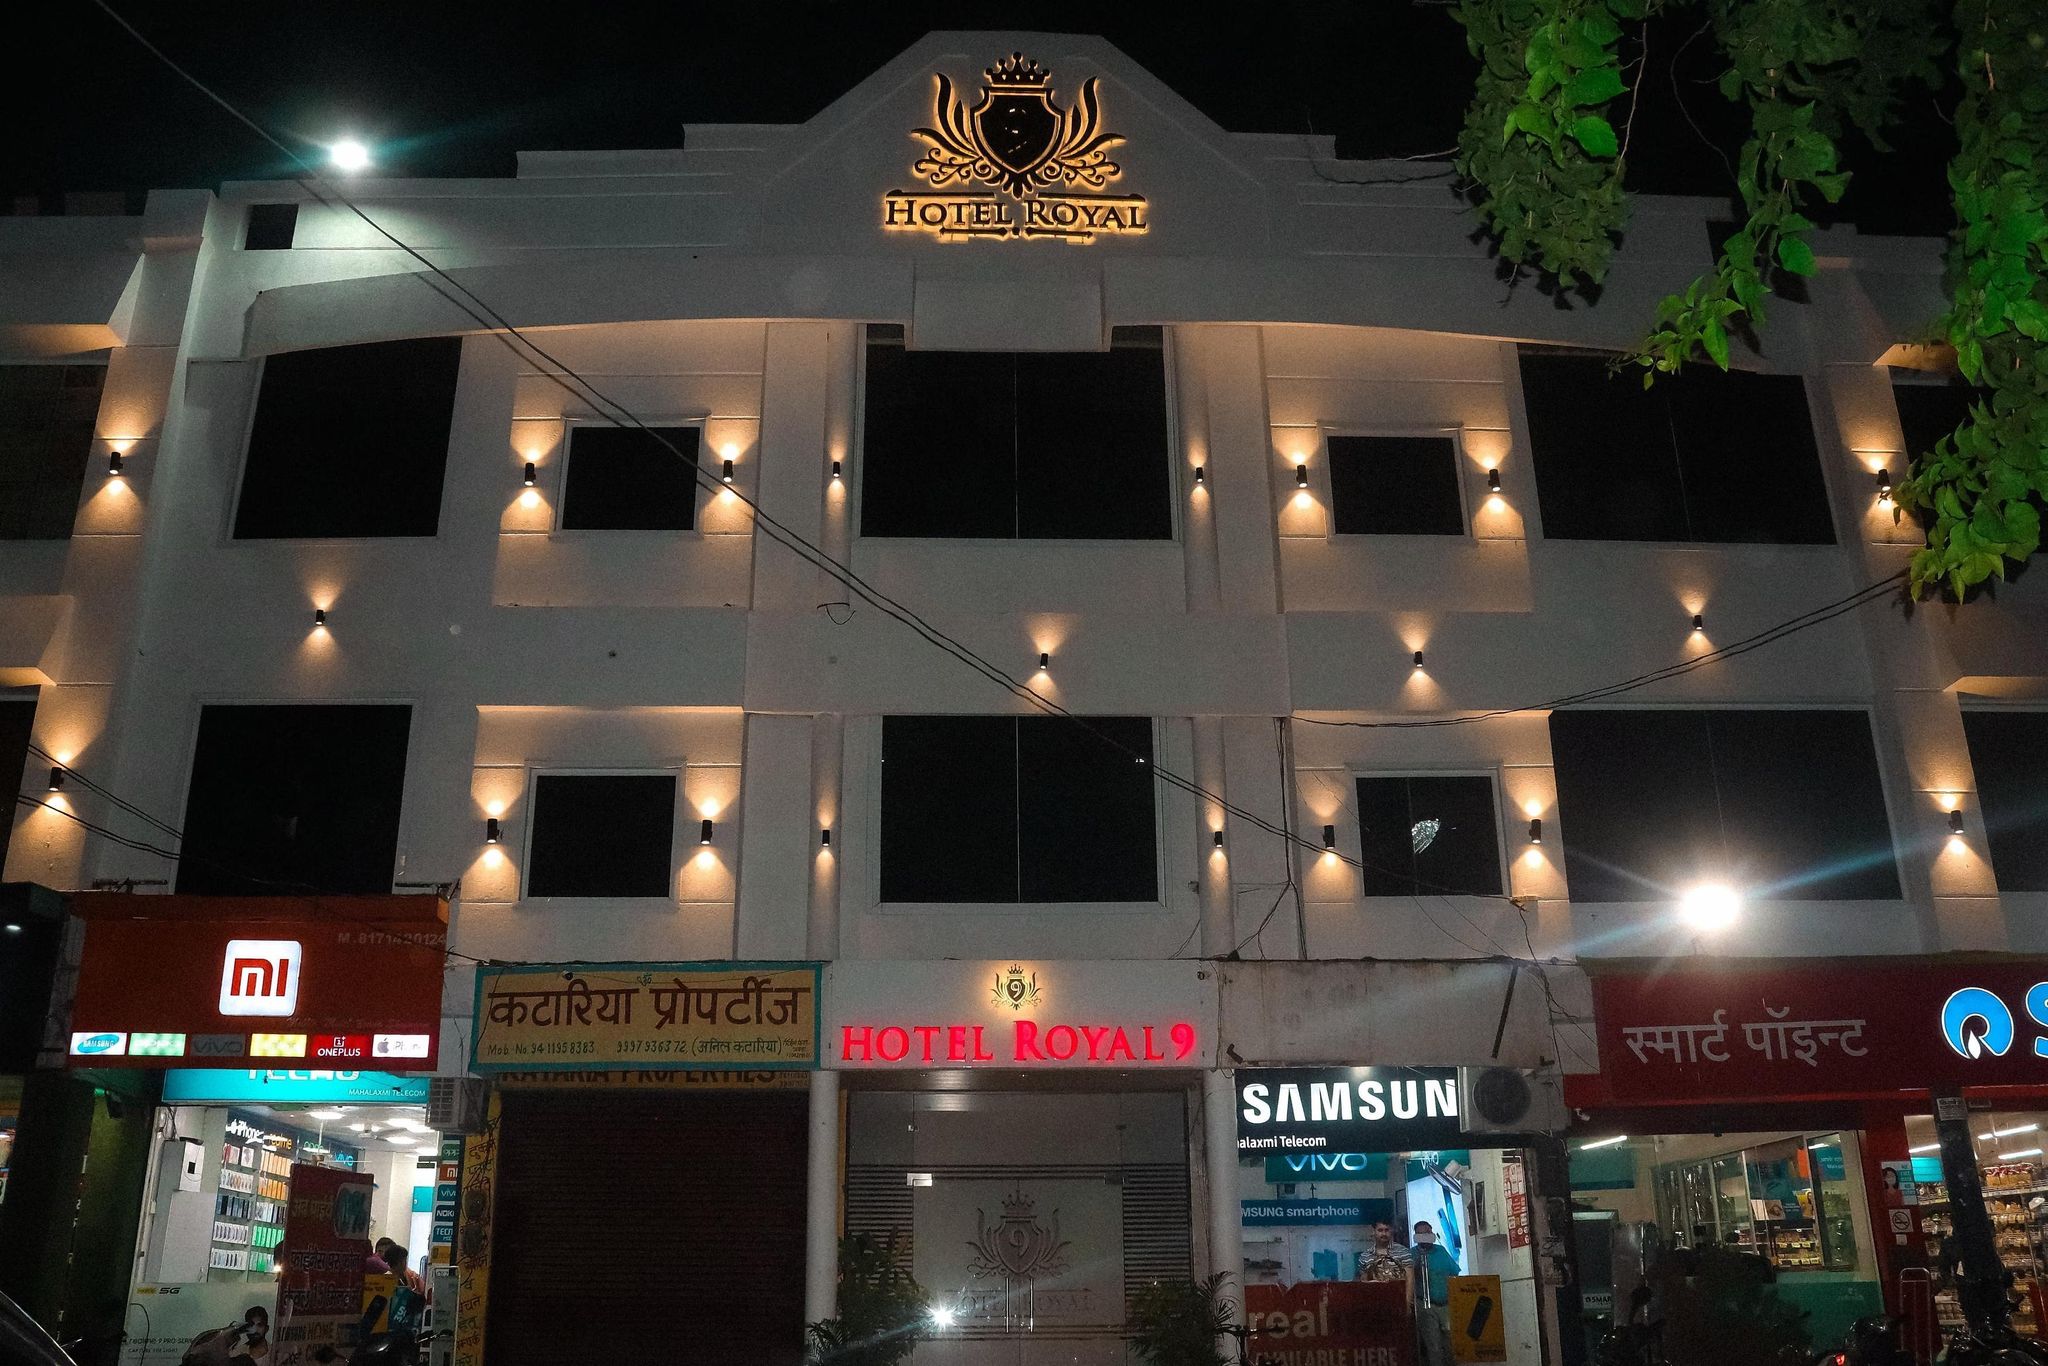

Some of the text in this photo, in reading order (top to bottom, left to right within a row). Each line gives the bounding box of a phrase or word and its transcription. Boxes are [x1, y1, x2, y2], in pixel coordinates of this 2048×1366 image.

[885, 199, 1148, 230] HOTEL ROYAL
[488, 976, 811, 1030] कटारिया प्रोपर्टीज
[841, 1026, 994, 1062] HOTEL
[1622, 1006, 1869, 1067] स्मार्ट पॉइन्ट
[317, 1048, 361, 1057] ONEPLUS
[1242, 1078, 1458, 1125] SAMSUN
[1279, 1134, 1327, 1148] Telecom
[1284, 1153, 1368, 1172] vivo
[440, 1189, 457, 1197] viv
[436, 1209, 455, 1218] NOKI
[1240, 1204, 1361, 1220] MSUNG smartphone
[435, 1227, 454, 1237] TECN
